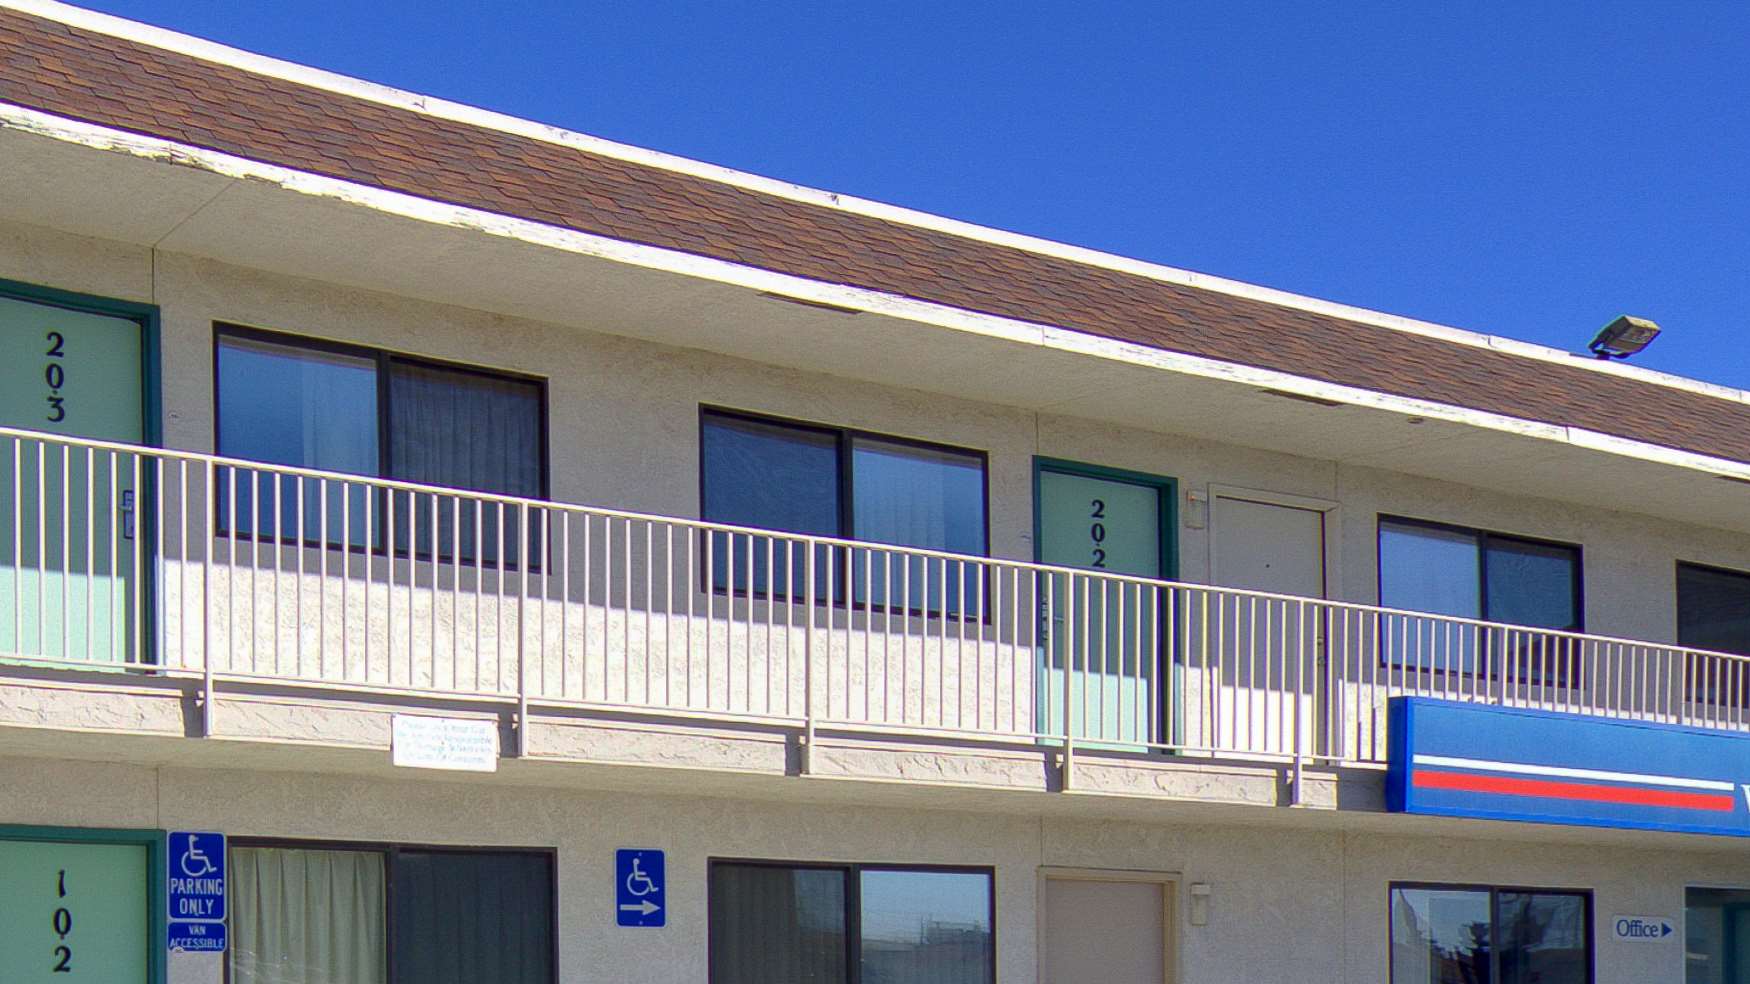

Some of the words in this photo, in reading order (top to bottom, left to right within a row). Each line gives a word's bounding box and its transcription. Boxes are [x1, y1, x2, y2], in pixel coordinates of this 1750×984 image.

[46, 332, 65, 422] 203
[1091, 499, 1106, 568] 202
[170, 878, 224, 895] PARKING
[179, 898, 215, 916] ONLY
[53, 869, 72, 973] 102
[1616, 919, 1659, 937] Office
[188, 925, 207, 936] VAN
[170, 938, 225, 950] ACCESSIBLE
